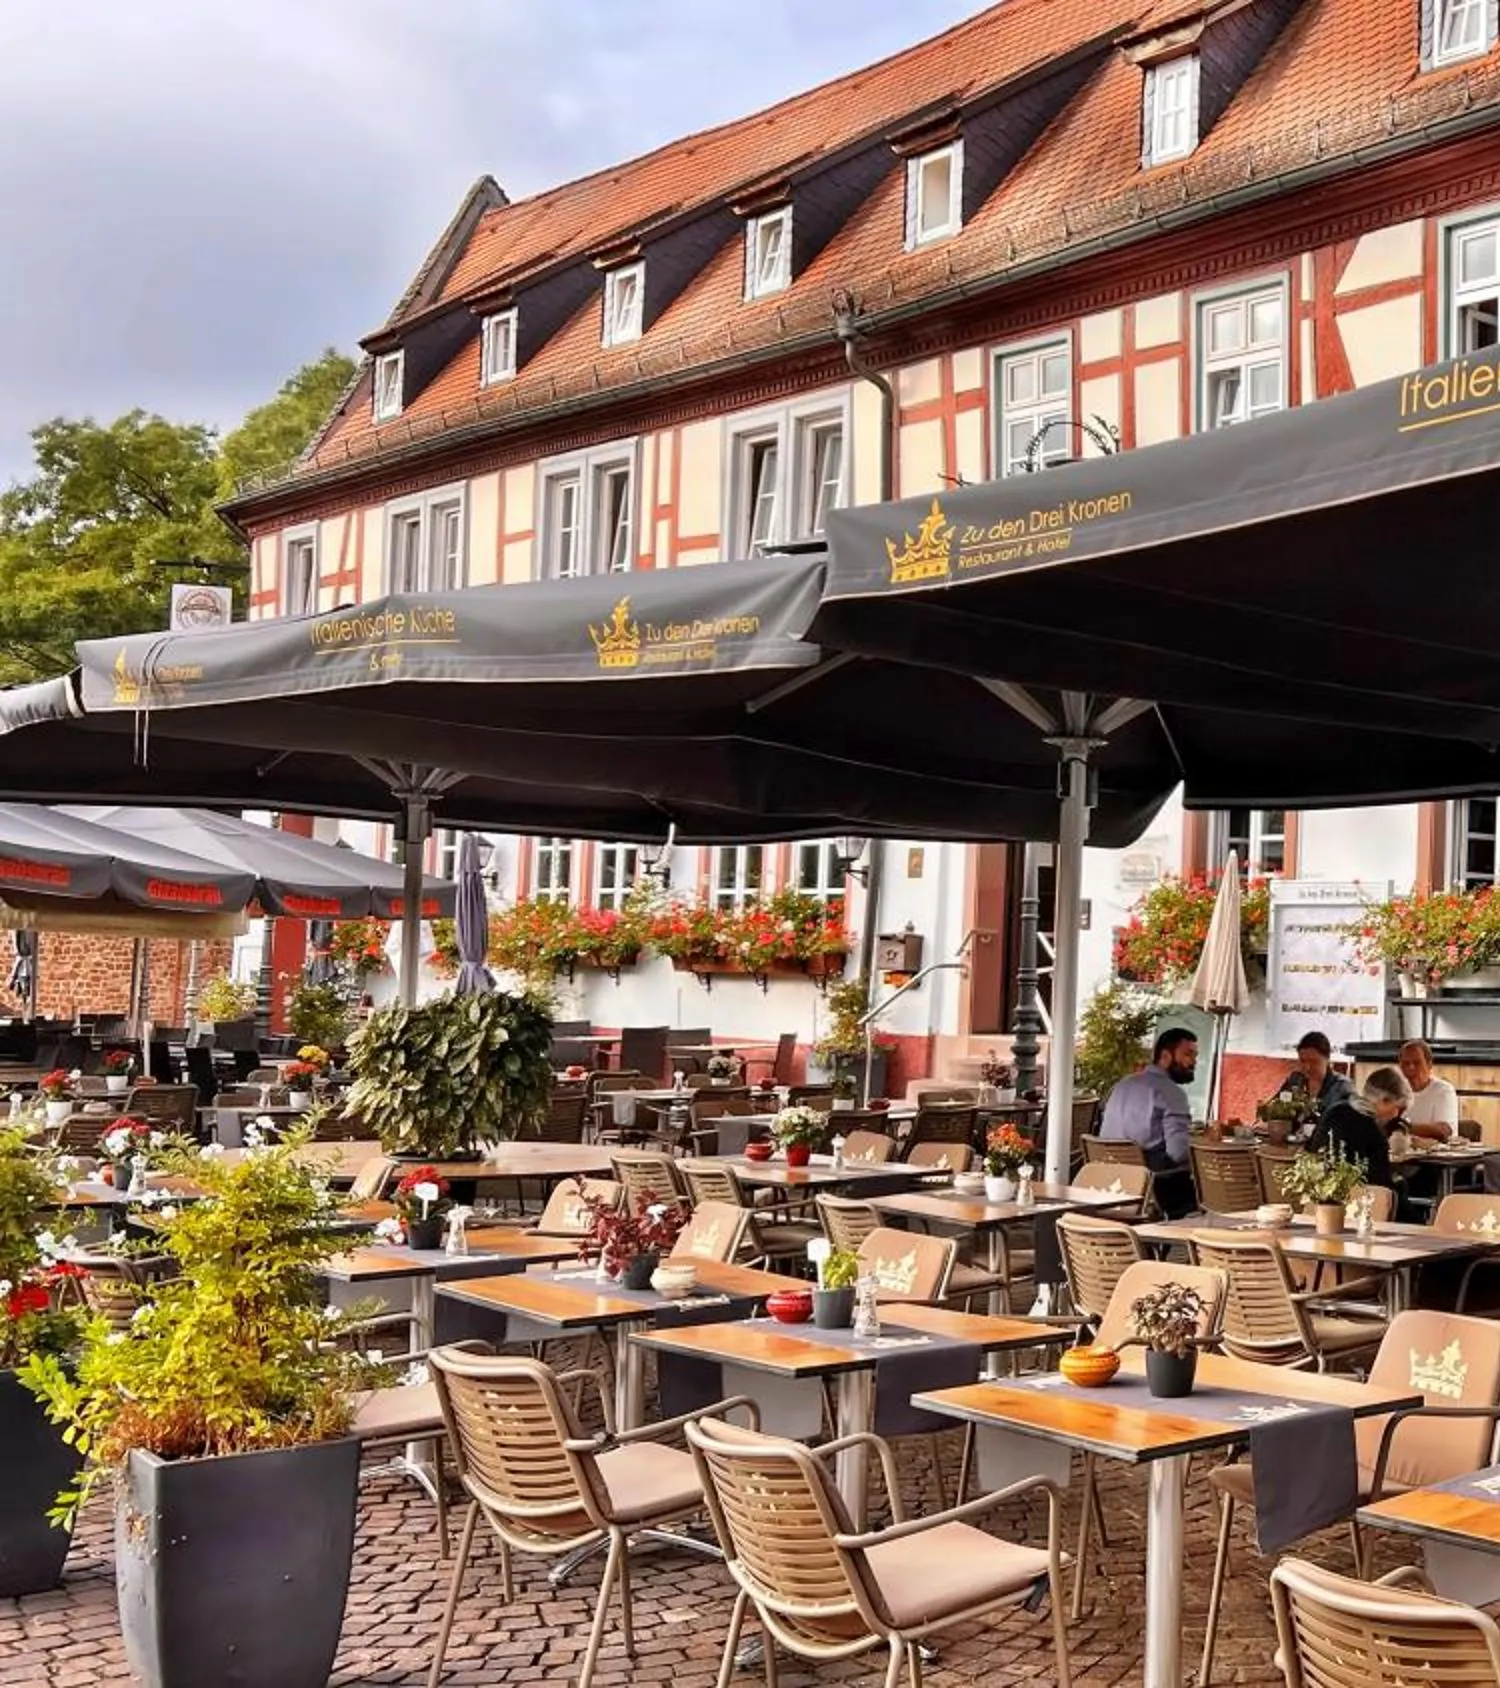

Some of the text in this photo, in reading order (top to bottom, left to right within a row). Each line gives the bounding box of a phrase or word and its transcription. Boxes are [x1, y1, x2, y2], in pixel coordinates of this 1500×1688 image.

[961, 493, 1131, 543] Zu den Drei Kronen
[959, 545, 1022, 569] Restaurant
[311, 605, 456, 646] Italienische Küche
